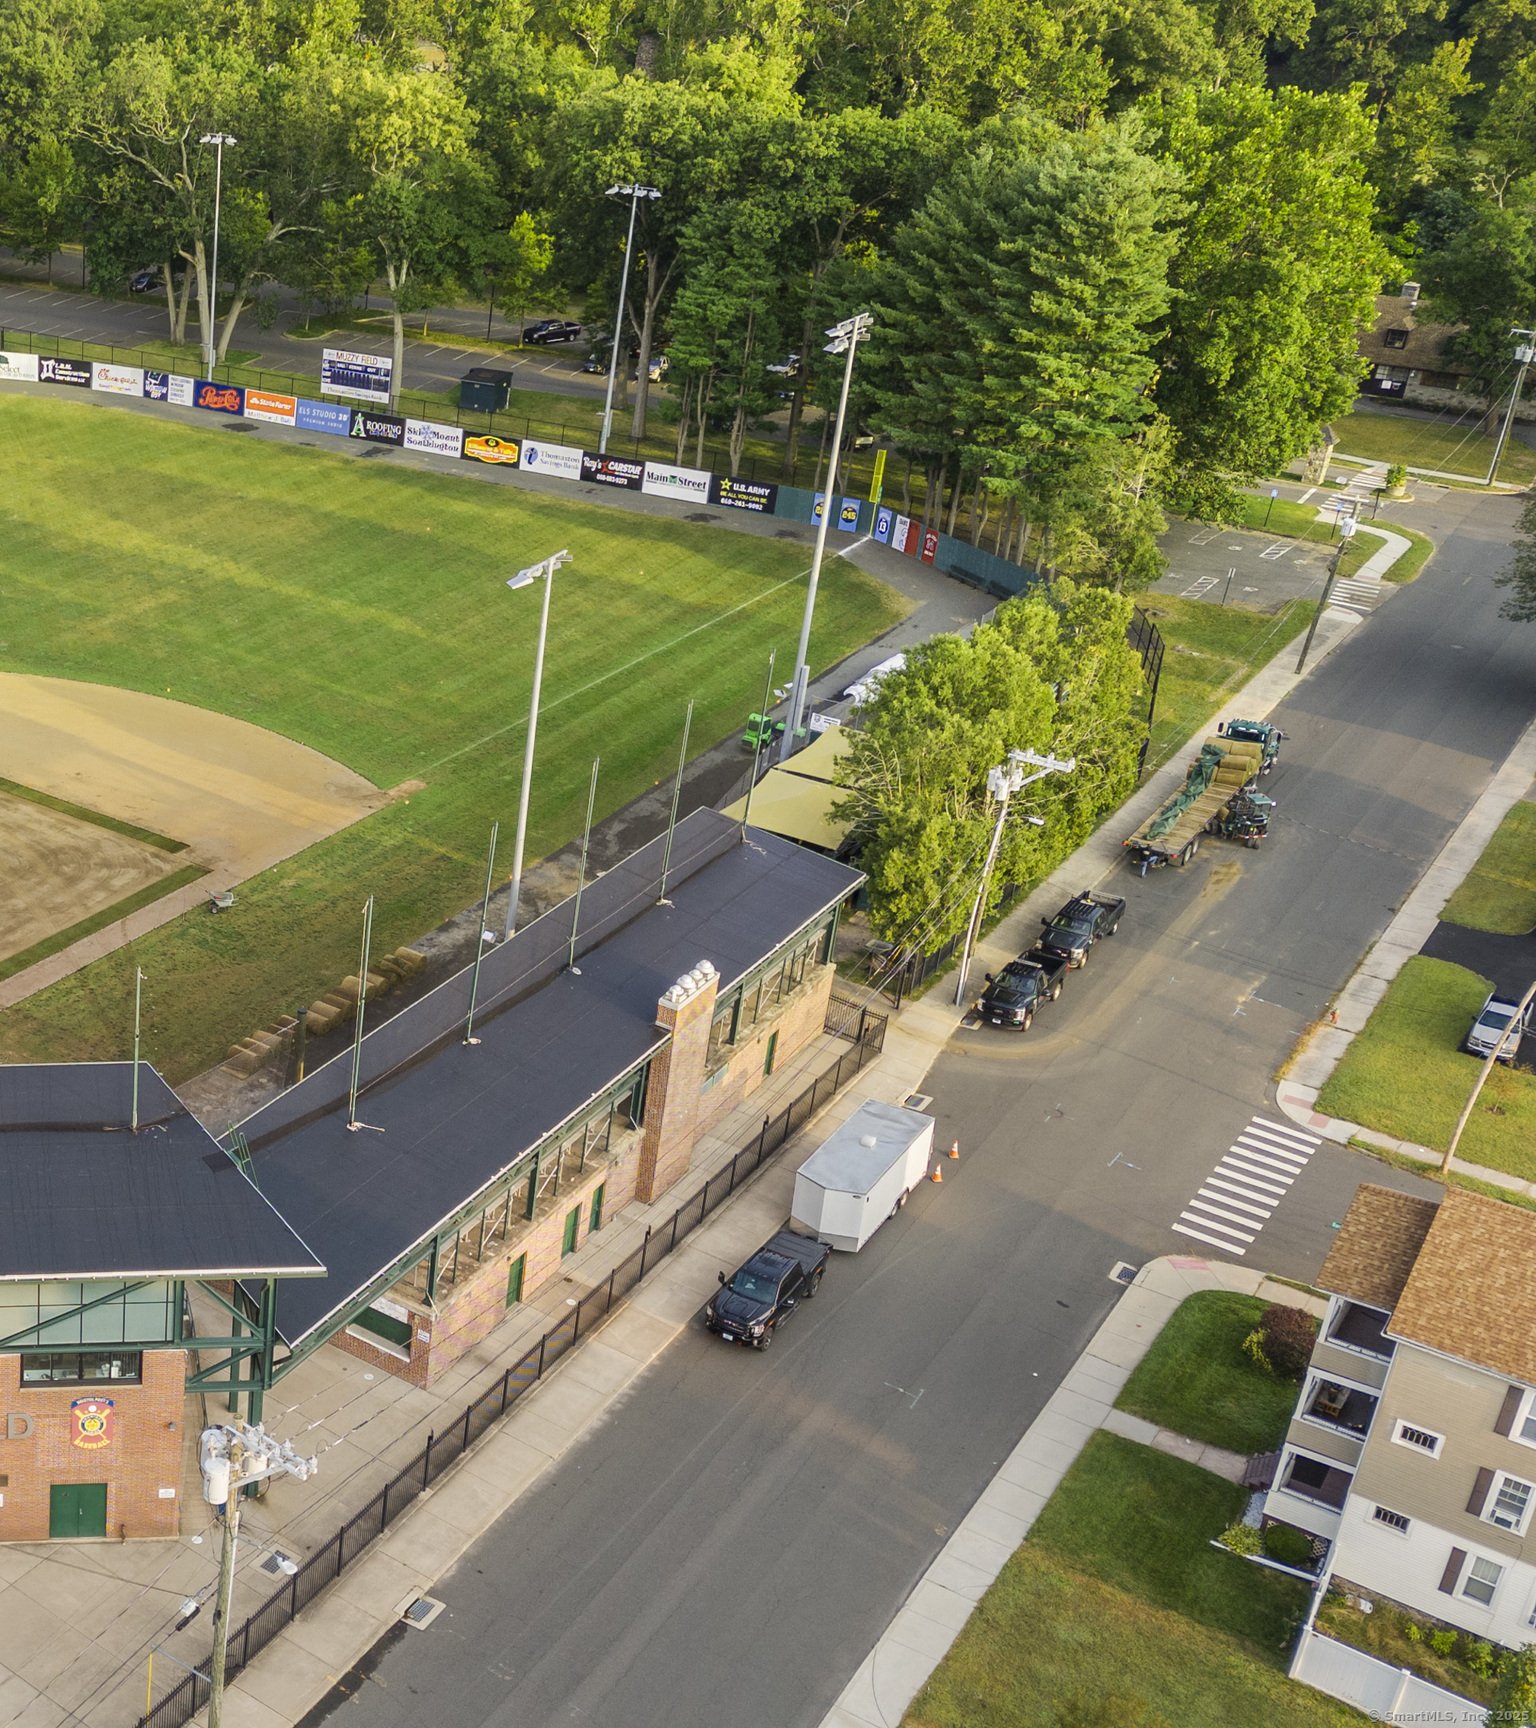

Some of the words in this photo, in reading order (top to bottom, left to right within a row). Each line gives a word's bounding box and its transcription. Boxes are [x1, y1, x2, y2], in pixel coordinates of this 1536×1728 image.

[336, 352, 360, 363] MUZZY
[361, 355, 378, 366] FIELD
[312, 409, 337, 420] STUDIO
[366, 421, 402, 435] ROOFING
[407, 426, 422, 436] Ski
[432, 431, 460, 442] Mount
[406, 437, 459, 452] Southington
[540, 450, 580, 464] Thomaston
[540, 458, 563, 469] Savings
[608, 461, 642, 475] CARSTAR
[647, 470, 668, 483] Main
[677, 476, 707, 489] Street
[747, 484, 771, 497] ARMY
[73, 1438, 111, 1449] BASEBALL
